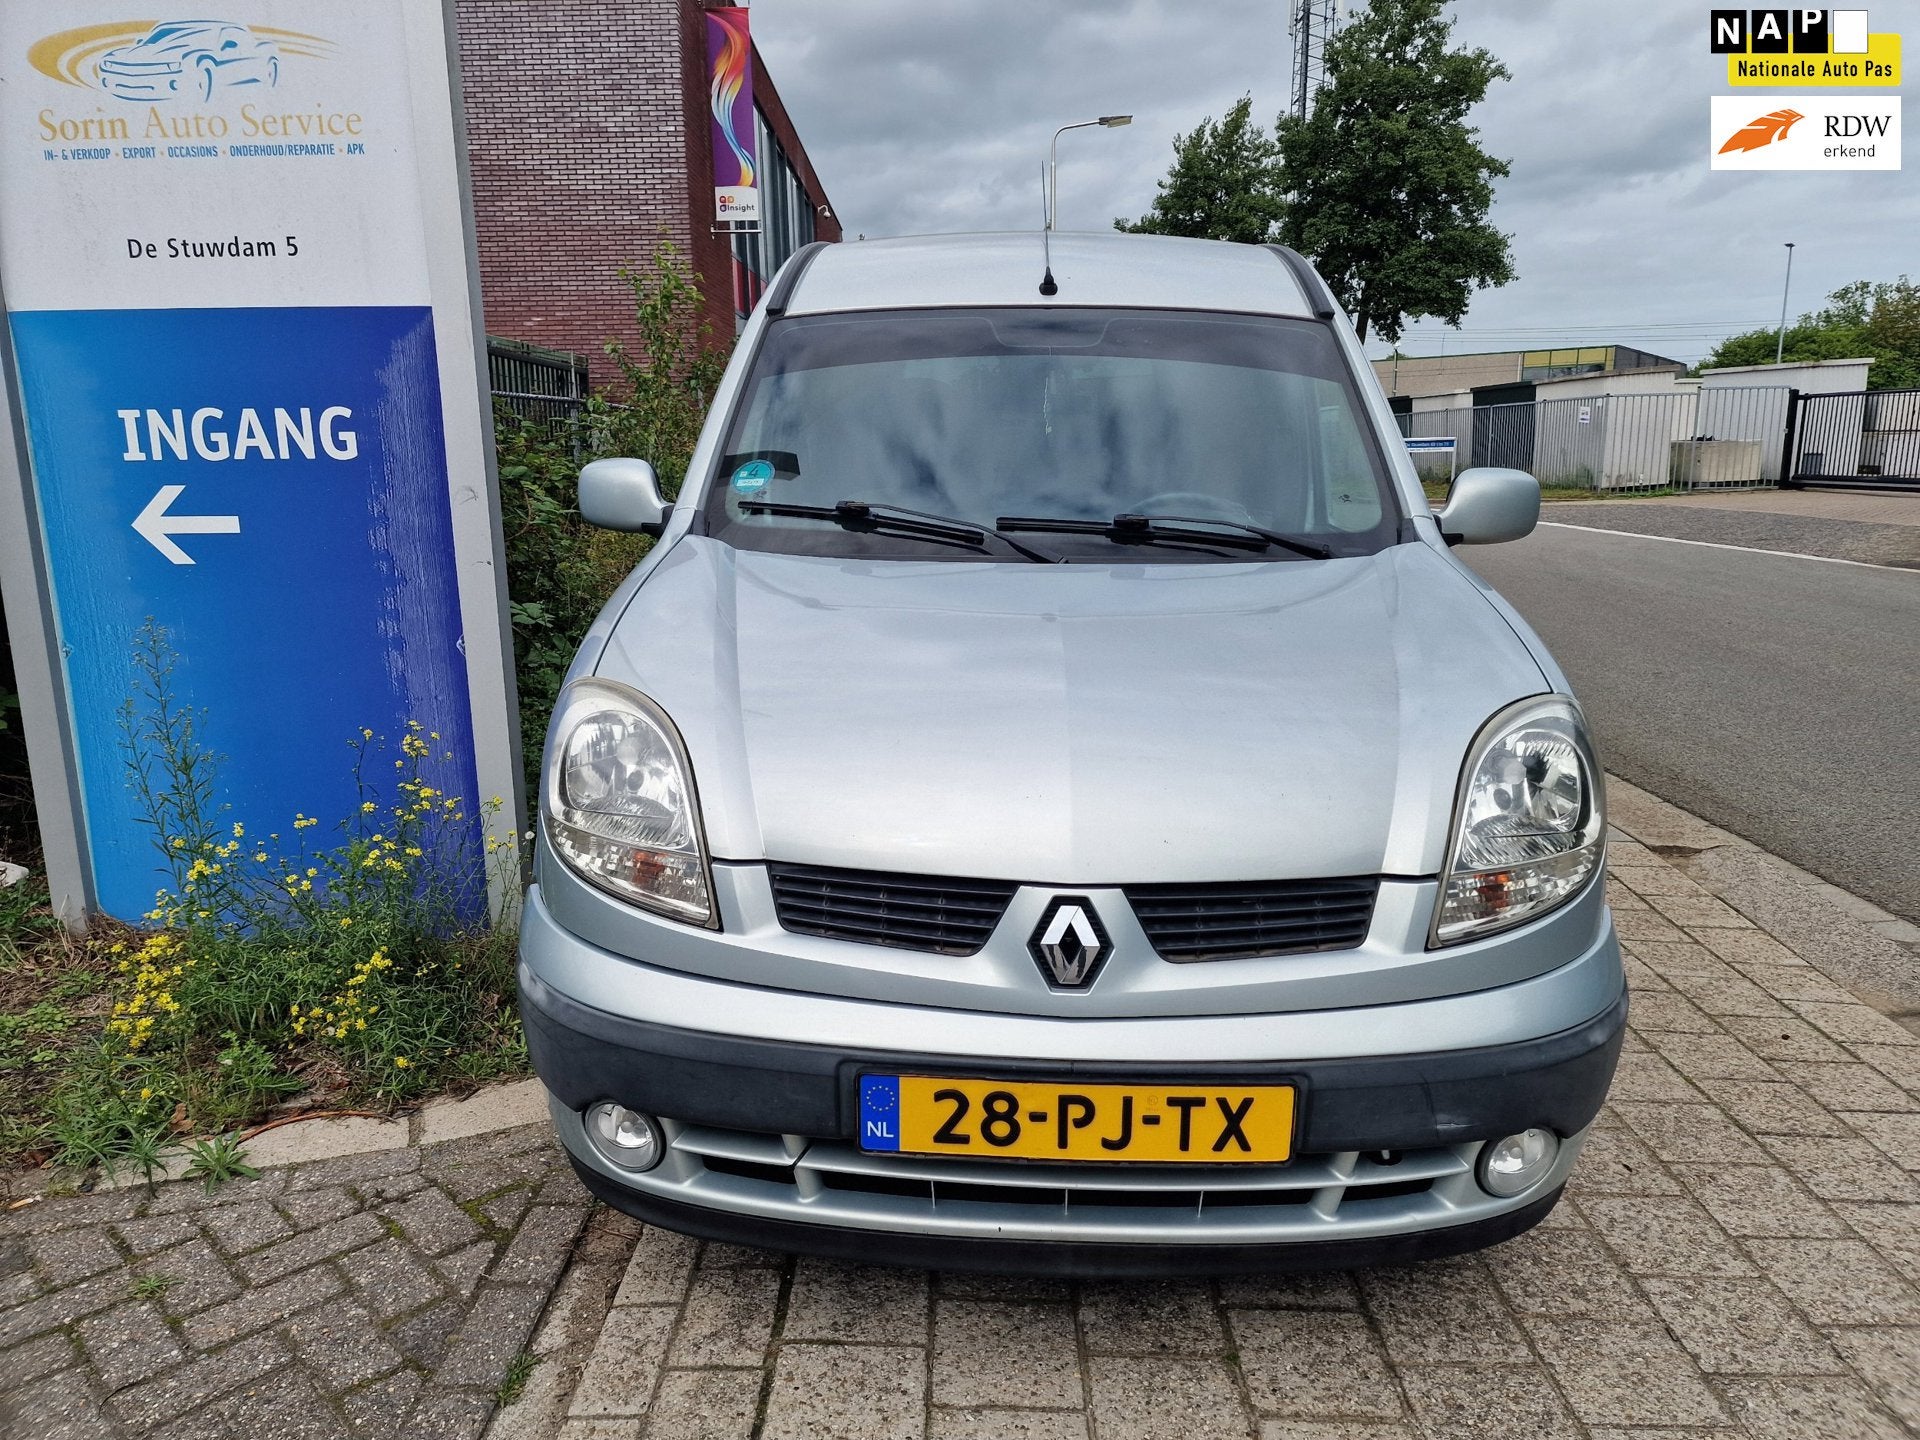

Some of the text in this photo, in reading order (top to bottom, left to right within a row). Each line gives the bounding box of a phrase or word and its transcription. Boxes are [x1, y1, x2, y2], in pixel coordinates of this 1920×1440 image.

[38, 102, 363, 142] Sorin Auto Service
[61, 149, 69, 161] &
[70, 148, 111, 161] VERKOOP
[122, 146, 156, 159] EXPORT
[167, 145, 219, 158] OCCASIONS
[229, 143, 336, 157] ONDERHOUD/REPARATIE
[346, 143, 366, 155] APK
[127, 235, 299, 258] De Stuwdam 5
[117, 406, 359, 462] INGANG
[867, 1120, 894, 1139] NL
[932, 1088, 1255, 1153] 28-PJ-TX
